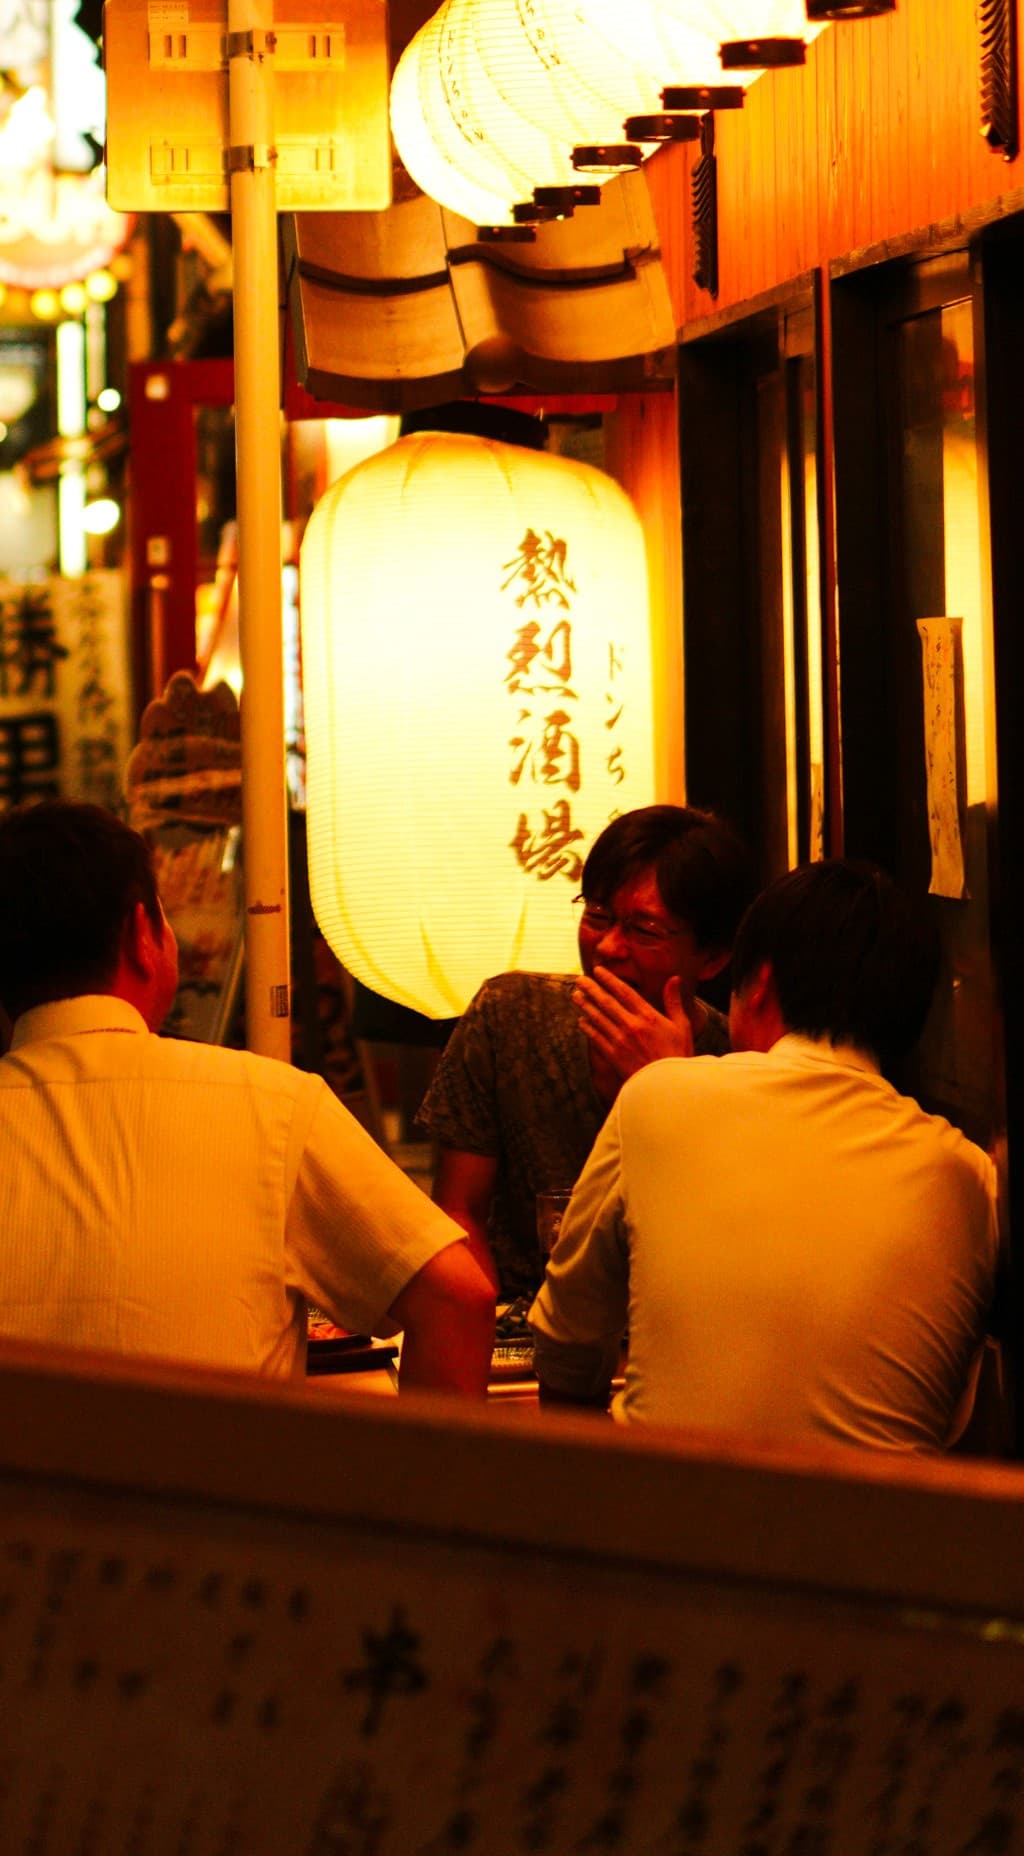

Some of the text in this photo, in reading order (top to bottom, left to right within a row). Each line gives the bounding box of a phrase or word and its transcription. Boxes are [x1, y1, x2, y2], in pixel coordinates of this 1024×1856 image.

[500, 527, 585, 883] 熱烈酒場
[604, 640, 626, 823] ドンち
